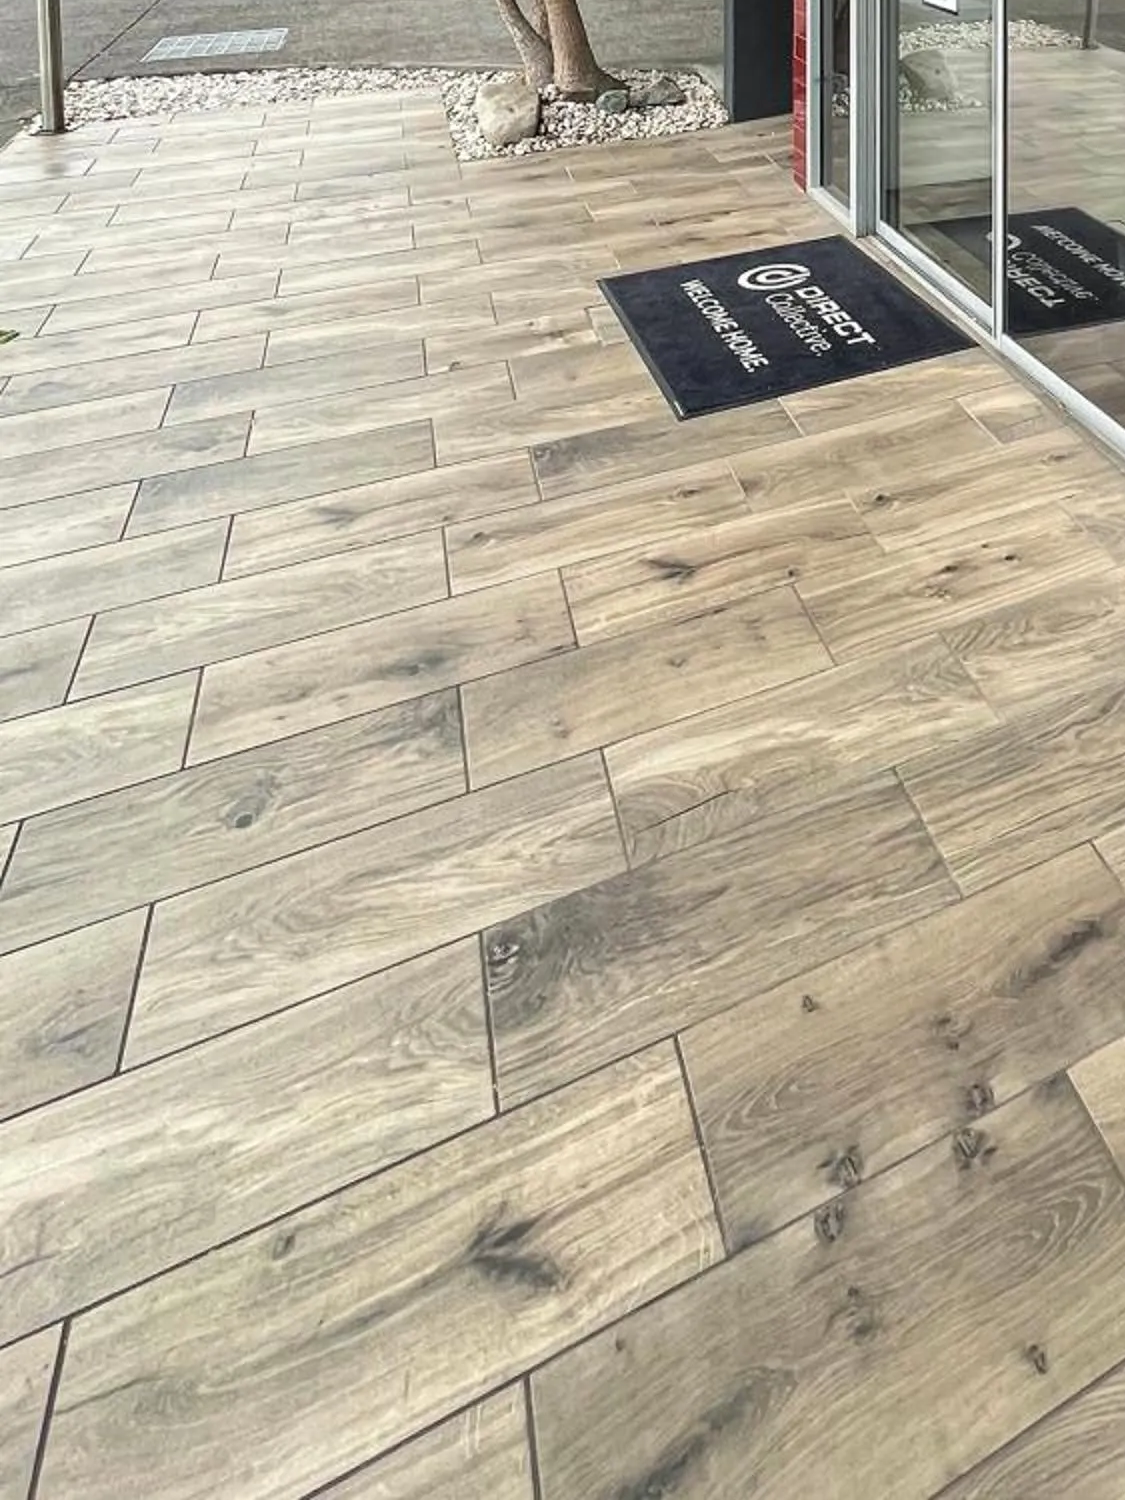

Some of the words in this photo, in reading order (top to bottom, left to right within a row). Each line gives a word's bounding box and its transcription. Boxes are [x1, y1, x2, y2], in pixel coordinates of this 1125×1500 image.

[679, 278, 740, 334] WELCOME
[720, 328, 770, 374] HOME.
[764, 292, 833, 358] Collective.
[793, 284, 876, 346] DIRECT
